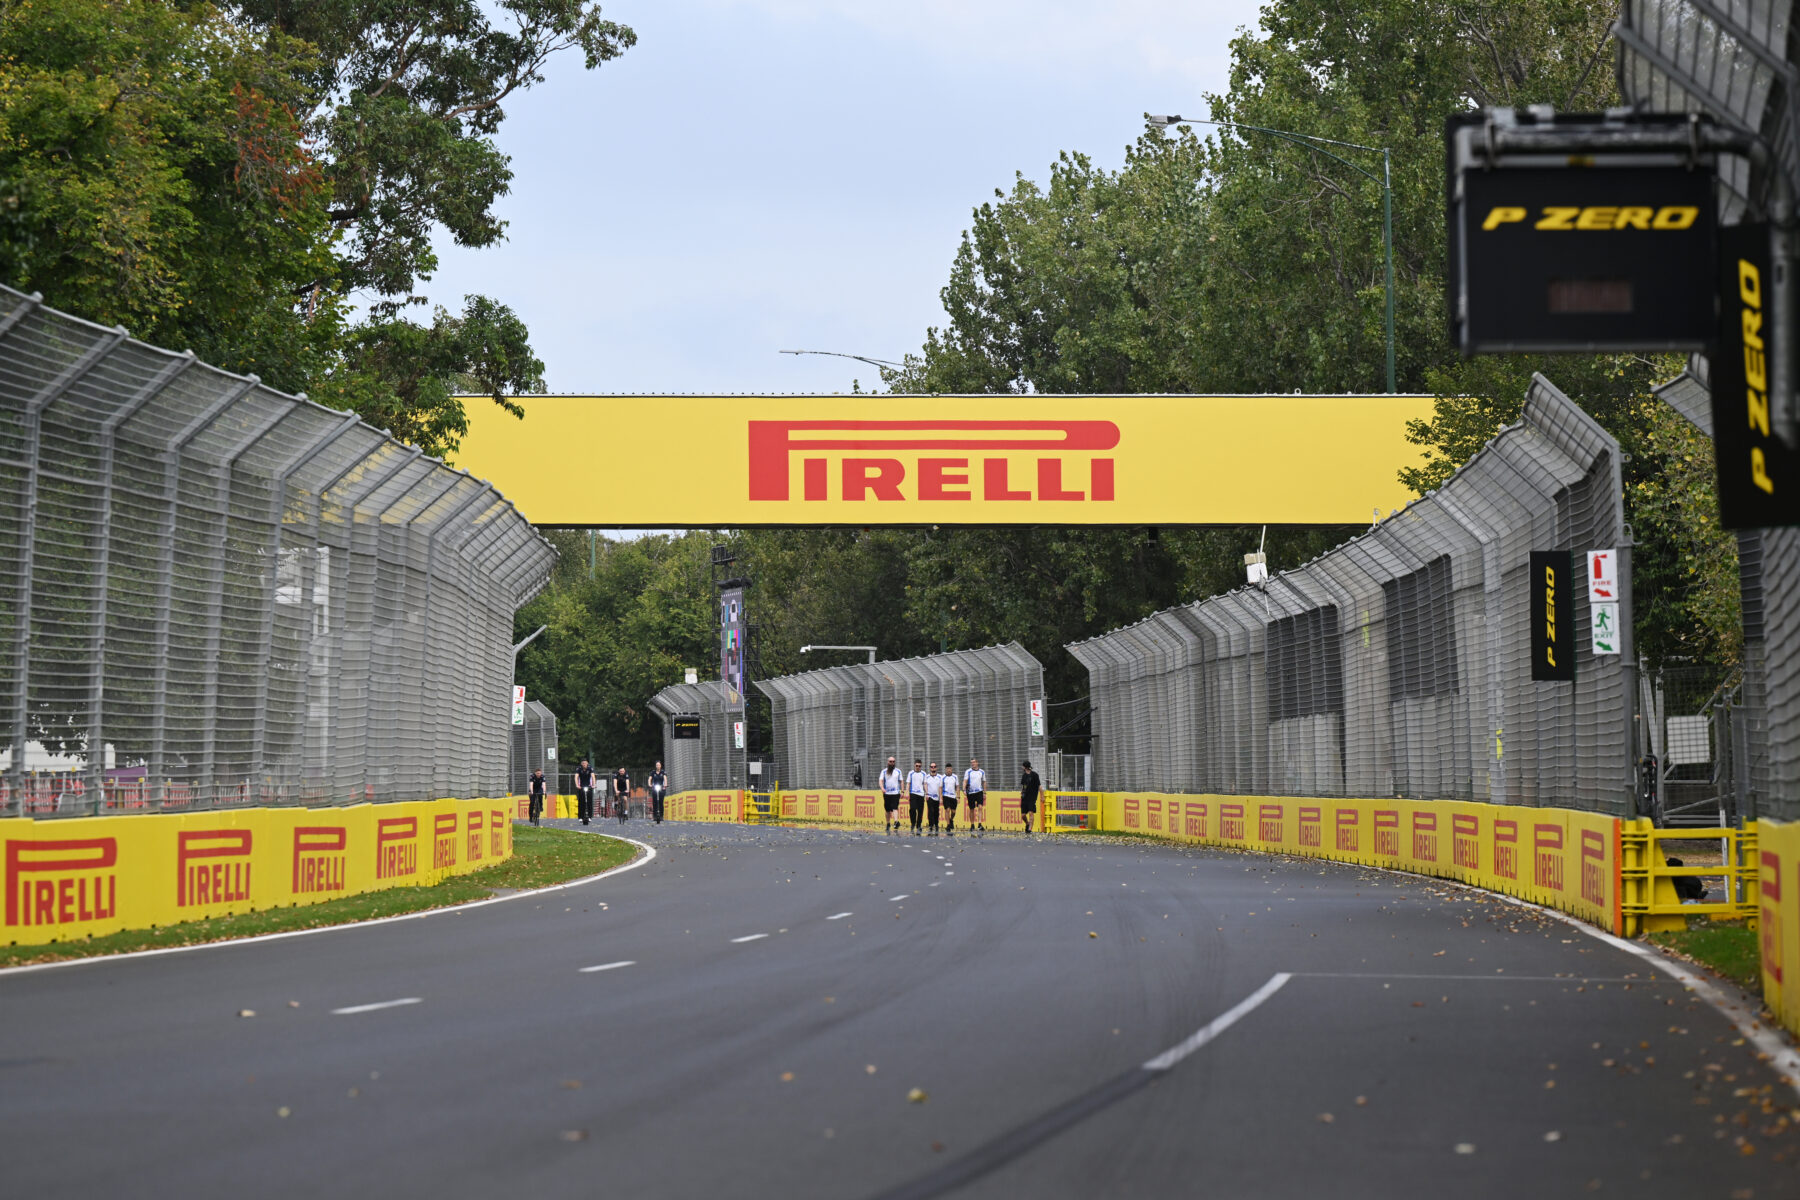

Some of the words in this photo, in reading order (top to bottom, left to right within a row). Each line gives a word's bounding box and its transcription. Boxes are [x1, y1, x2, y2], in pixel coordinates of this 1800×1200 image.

[1482, 207, 1527, 230] P
[1534, 206, 1699, 230] ZERO
[1738, 258, 1770, 437] ZERO
[748, 420, 1121, 501] PIRELLI
[1751, 446, 1774, 494] P
[1546, 566, 1556, 643] ZERO
[1547, 646, 1556, 667] P
[706, 795, 732, 815] PIRELLI
[855, 796, 875, 818] PIRELLI
[1185, 803, 1207, 837] PIRELLI
[1220, 804, 1244, 840] PIRELLI
[1259, 805, 1283, 842] PIRELLI
[1299, 807, 1320, 847] PIRELLI
[377, 817, 418, 879] PIRELLI
[1336, 809, 1358, 852] PIRELLI
[1374, 810, 1399, 856] PIRELLI
[1413, 812, 1437, 862] PIRELLI
[1452, 814, 1479, 870] PIRELLI
[1494, 820, 1518, 880] PIRELLI
[5, 837, 117, 927] PIRELLI
[177, 829, 253, 907] PIRELLI
[293, 827, 346, 894] PIRELLI
[1534, 824, 1563, 891] PIRELLI
[1581, 829, 1605, 907] PIRELLI
